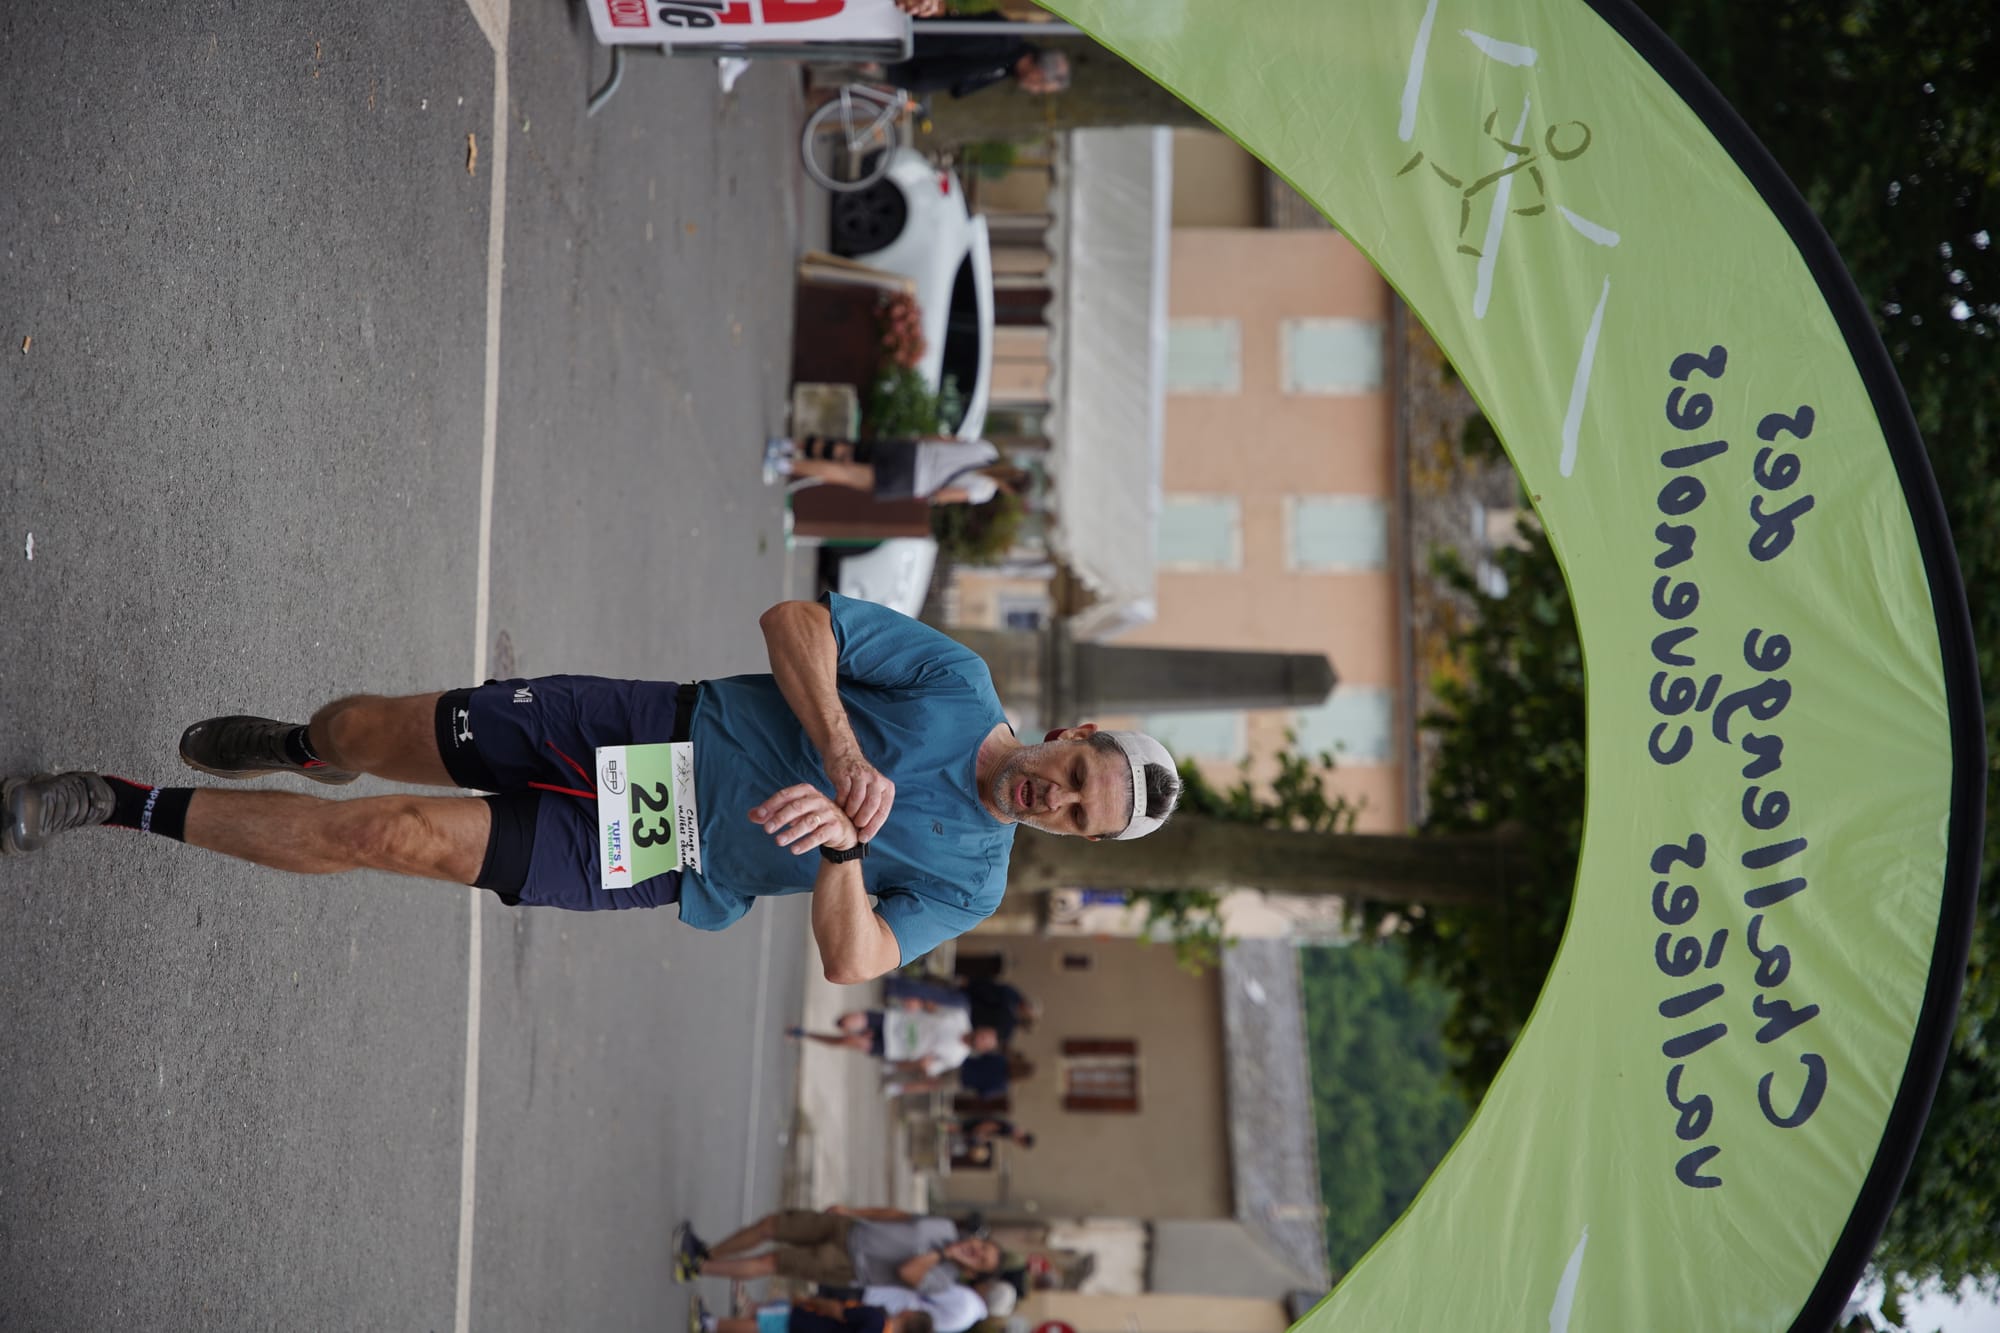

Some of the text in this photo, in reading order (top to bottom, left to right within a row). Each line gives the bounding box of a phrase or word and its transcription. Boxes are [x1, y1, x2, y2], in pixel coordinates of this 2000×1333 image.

[608, 760, 618, 790] BFP
[631, 782, 671, 848] 23
[687, 808, 695, 852] Challenge
[607, 825, 615, 865] Aventure
[611, 820, 622, 861] TUFF'S
